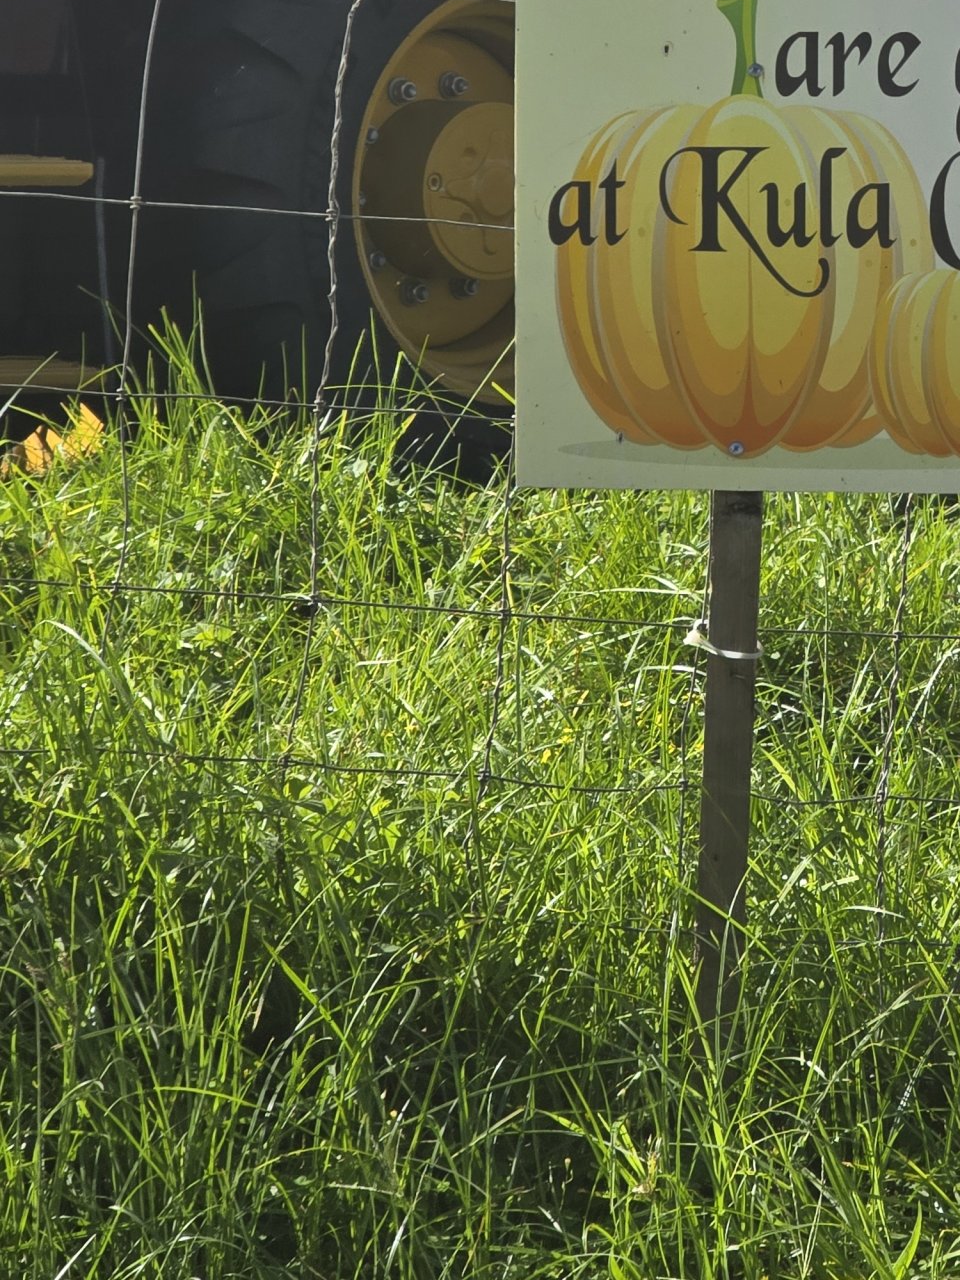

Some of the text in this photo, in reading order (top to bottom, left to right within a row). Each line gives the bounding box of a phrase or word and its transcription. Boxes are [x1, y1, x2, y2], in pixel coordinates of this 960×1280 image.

[774, 31, 922, 98] are
[547, 157, 629, 247] at
[658, 146, 898, 298] Kula
